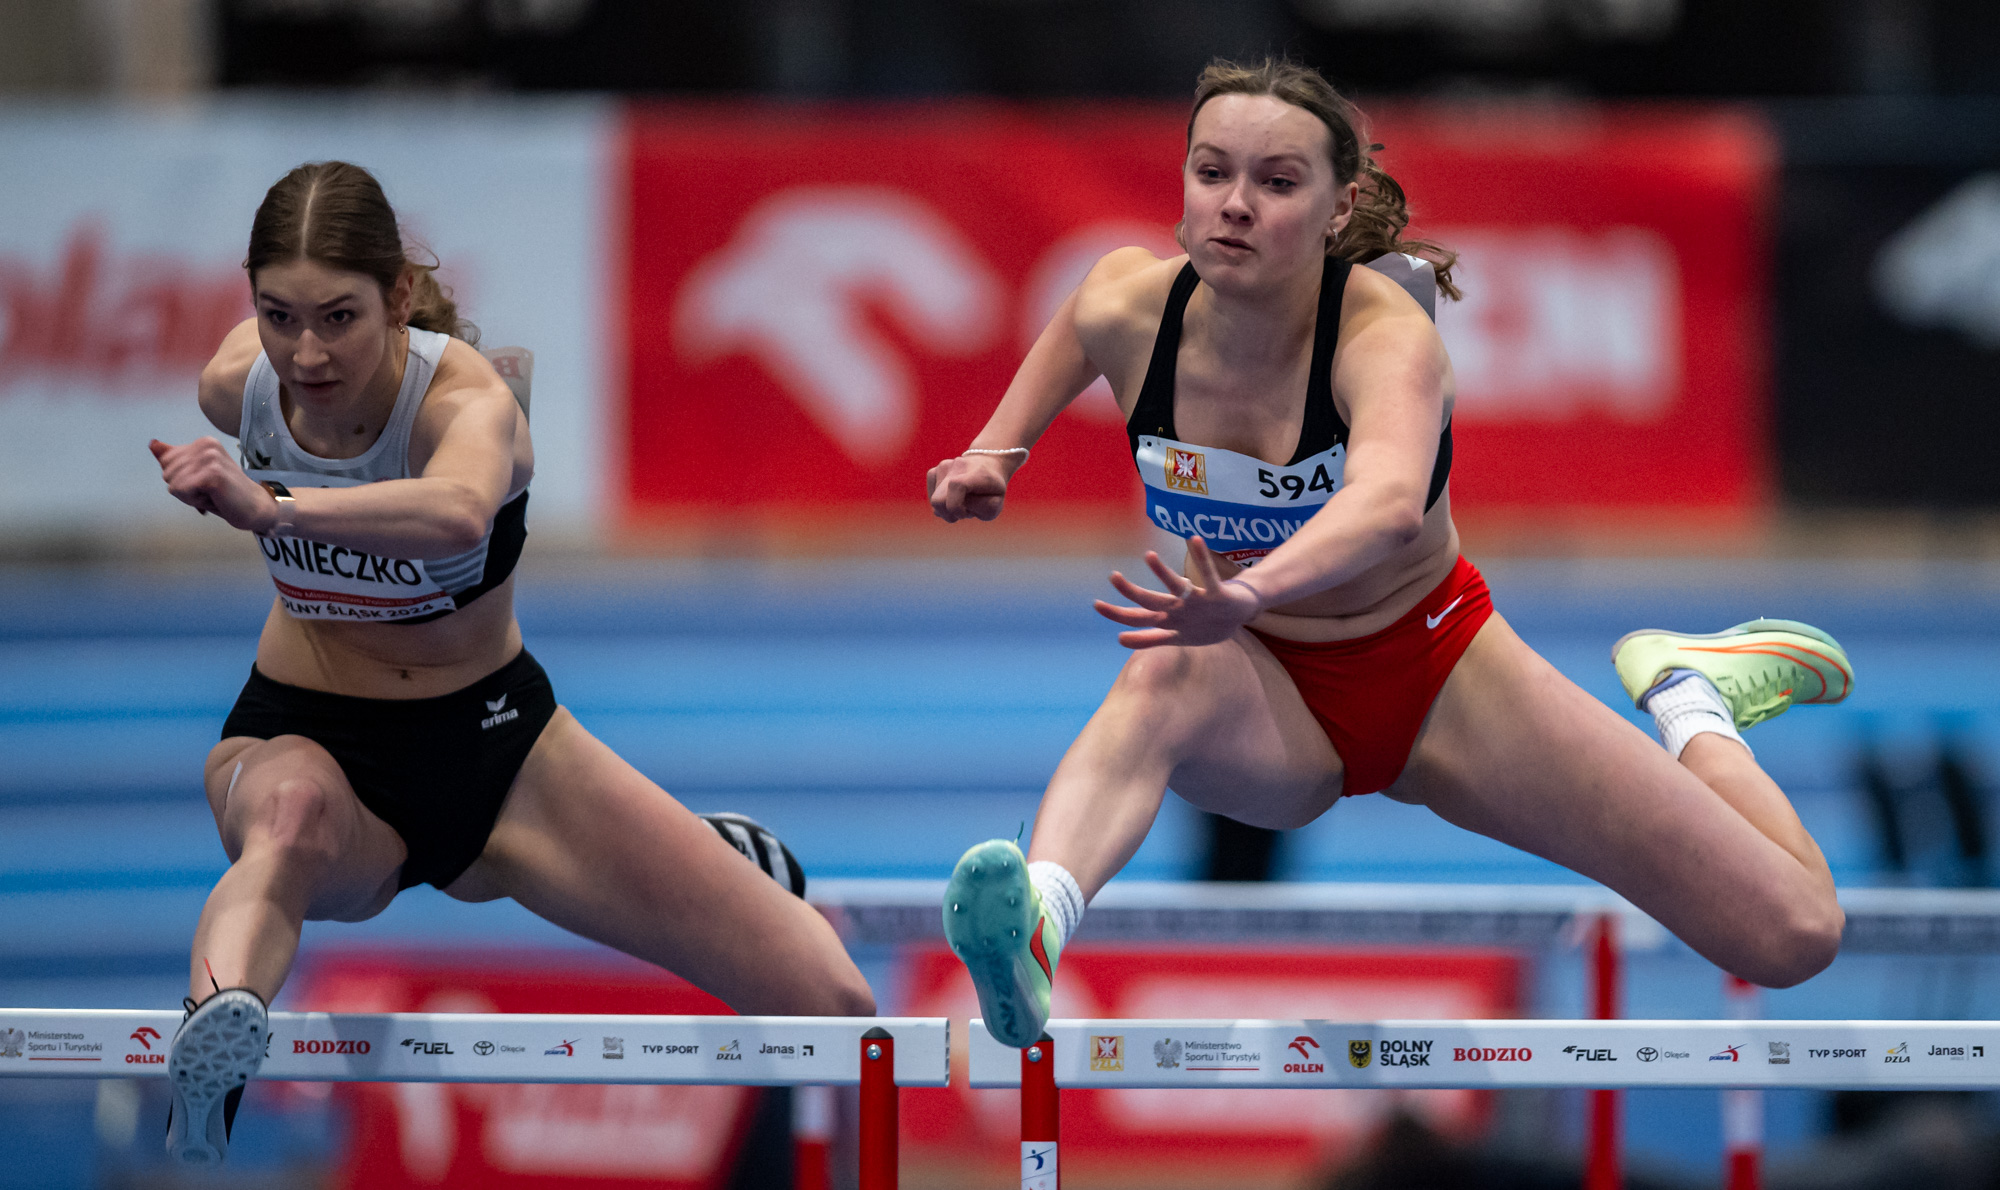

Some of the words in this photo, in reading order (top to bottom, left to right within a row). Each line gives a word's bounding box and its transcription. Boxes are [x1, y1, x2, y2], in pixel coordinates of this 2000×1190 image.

[1258, 463, 1335, 500] 594
[1155, 505, 1308, 543] RACZKOW
[327, 603, 382, 620] ŚLĄSK
[386, 604, 434, 618] 2024
[481, 708, 518, 729] erima
[28, 1031, 84, 1041] Ministerstwo
[28, 1042, 55, 1052] Sportu
[63, 1042, 103, 1052] Turystyki
[292, 1040, 371, 1055] BODZIO
[413, 1043, 455, 1055] FUEL
[643, 1045, 663, 1054] TVP
[666, 1045, 699, 1054] SPORT
[759, 1043, 795, 1054] Janas
[1185, 1041, 1242, 1050] Ministerstwo
[1380, 1040, 1434, 1053] DOLNY
[1928, 1045, 1964, 1056] Janas
[125, 1054, 165, 1064] ORLEN
[1185, 1052, 1213, 1062] Sportu
[1221, 1052, 1261, 1062] Turystyki
[1380, 1050, 1431, 1068] ŚLĄSK
[1453, 1047, 1533, 1062] BODZIO
[1576, 1049, 1618, 1061] FUEL
[1809, 1049, 1830, 1058] TVP
[1832, 1049, 1867, 1058] SPORT
[1284, 1063, 1324, 1073] ORLEN
